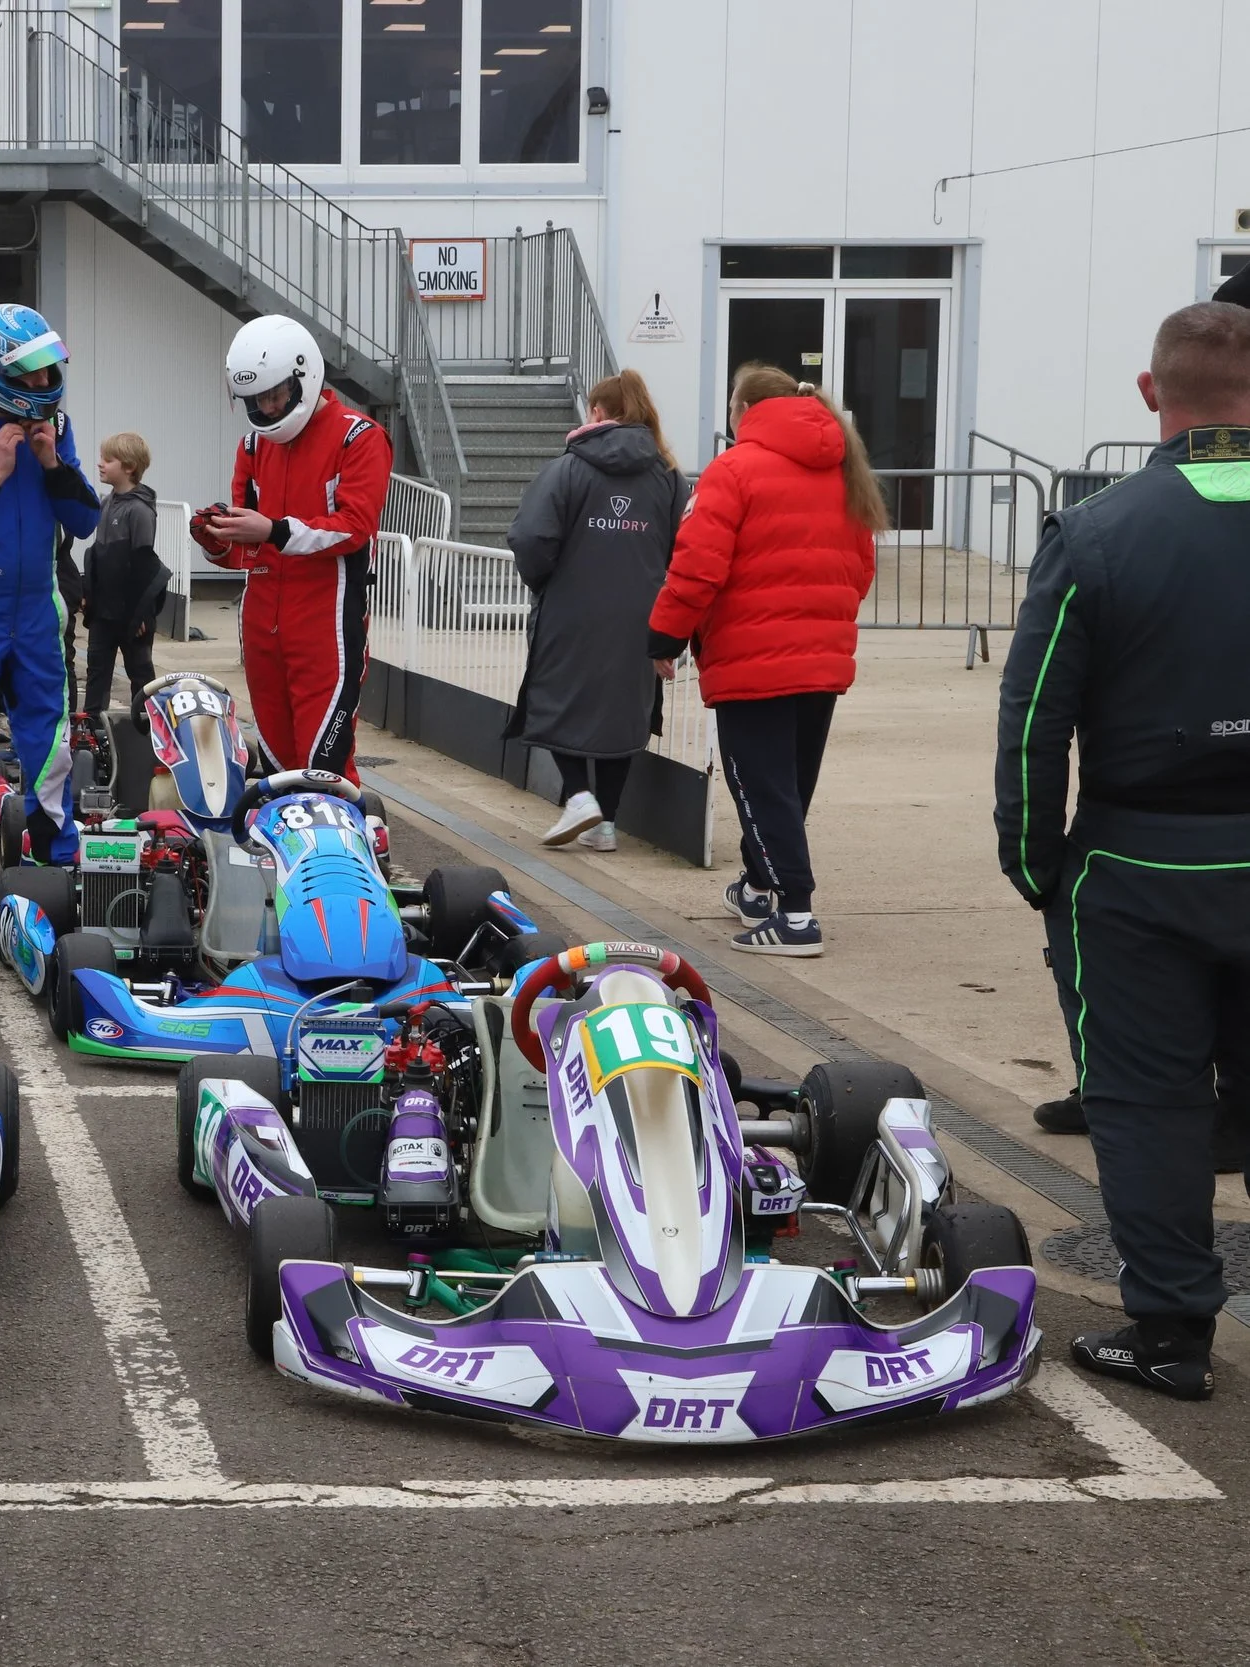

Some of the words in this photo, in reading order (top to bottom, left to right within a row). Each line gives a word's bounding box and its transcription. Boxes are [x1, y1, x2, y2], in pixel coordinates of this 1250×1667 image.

[438, 246, 457, 266] NO
[418, 271, 478, 291] SMOKING
[235, 371, 254, 382] Arai
[13, 399, 28, 409] BELL
[348, 421, 373, 442] sparco
[588, 517, 649, 532] EQUIDRY
[171, 690, 223, 717] 89
[320, 709, 347, 757] KERB
[305, 770, 340, 780] CKR
[281, 801, 360, 832] 818
[86, 841, 136, 860] GMS
[88, 1022, 119, 1034] CKR
[156, 1021, 213, 1038] GMS
[596, 1006, 695, 1065] 19
[565, 1051, 594, 1117] DRT
[404, 1097, 435, 1107] DRT
[393, 1142, 424, 1157] ROTAX
[758, 1196, 793, 1211] DRT
[404, 1224, 434, 1233] DRT
[395, 1344, 496, 1382] DRT
[1096, 1347, 1134, 1362] sparco
[865, 1348, 935, 1388] DRT
[643, 1397, 735, 1429] DRT
